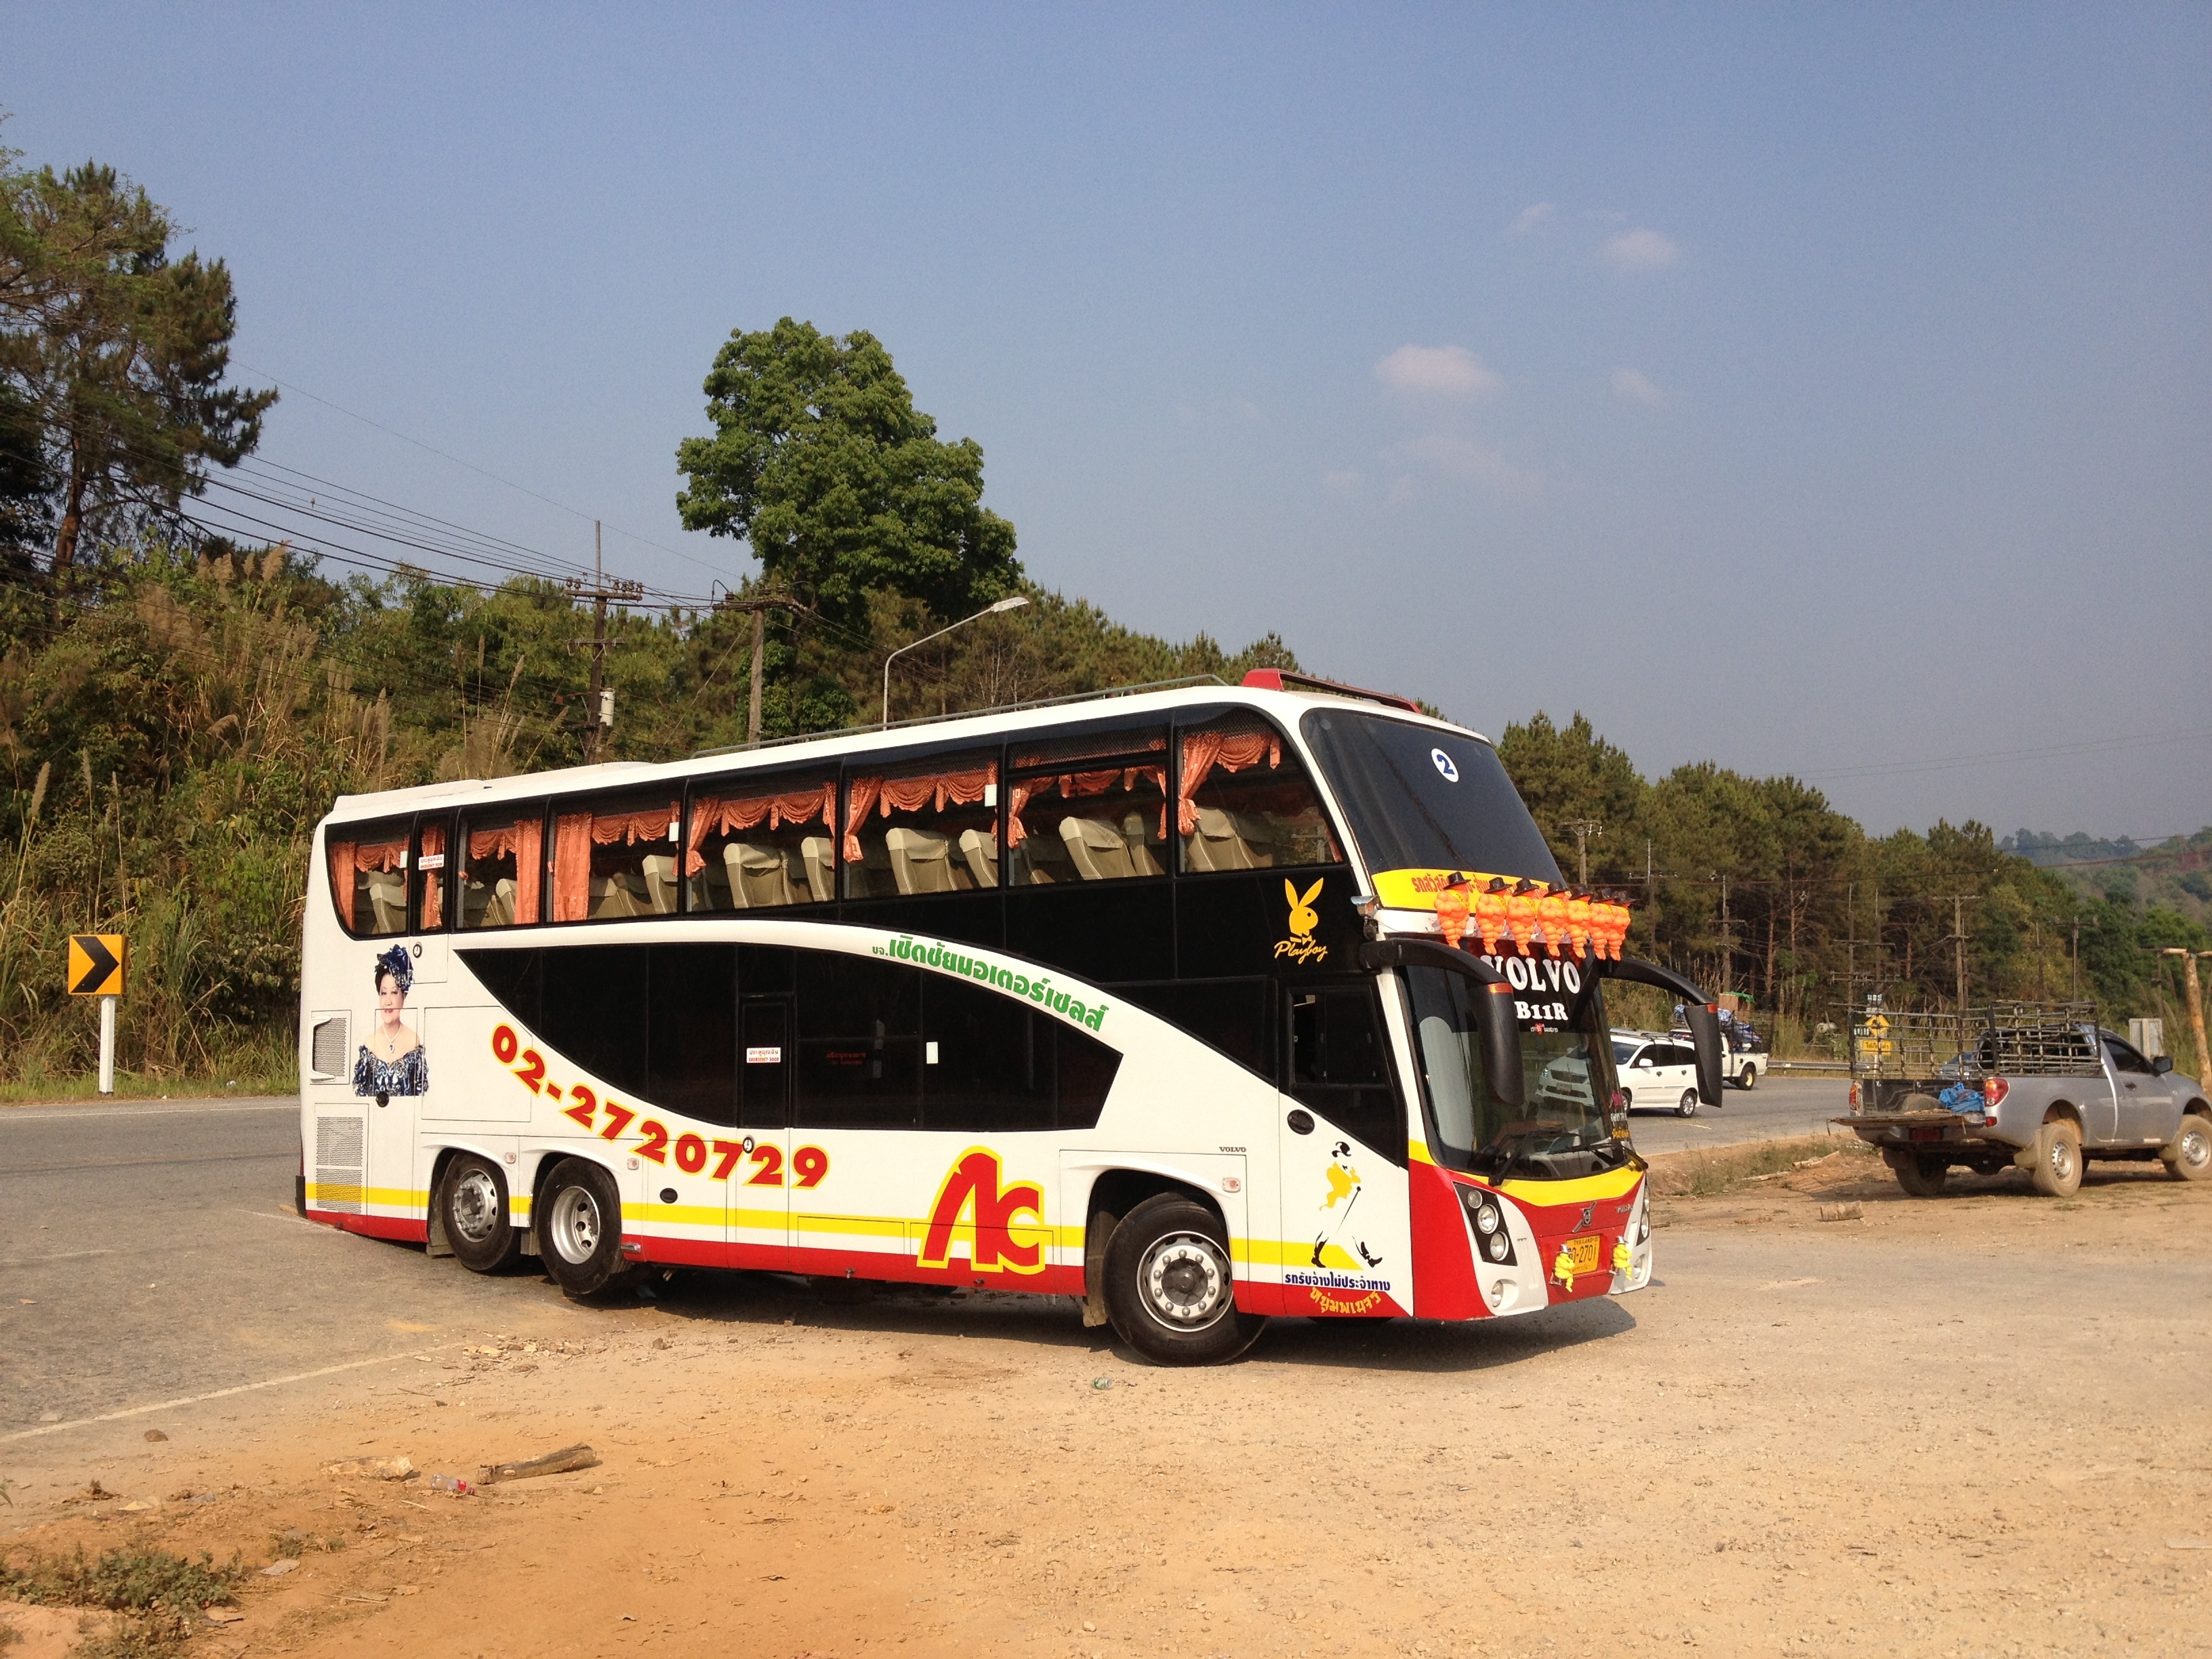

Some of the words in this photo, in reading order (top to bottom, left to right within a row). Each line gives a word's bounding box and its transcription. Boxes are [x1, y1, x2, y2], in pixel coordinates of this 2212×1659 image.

[1436, 754, 1455, 775] 2
[1274, 939, 1328, 964] Playboy
[1514, 1001, 1569, 1021] B11R
[491, 1023, 830, 1190] 02-2720729
